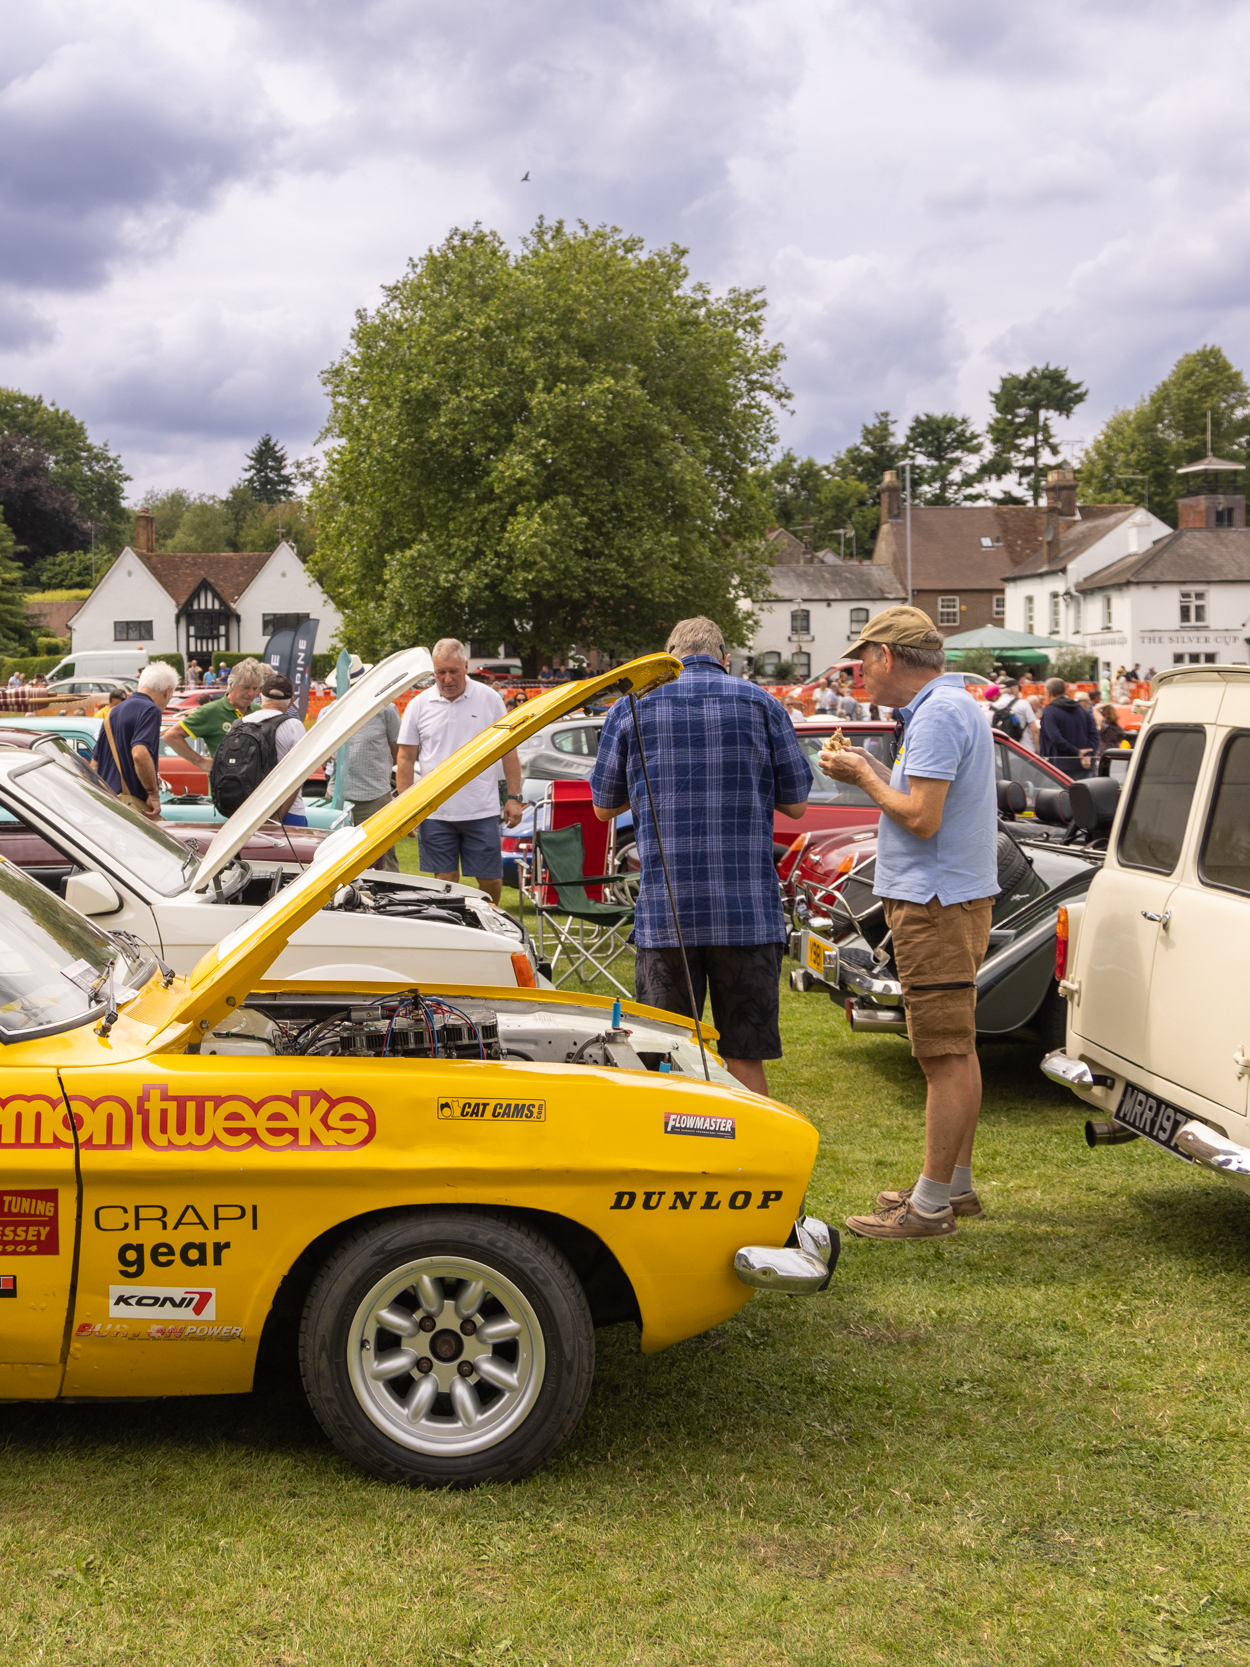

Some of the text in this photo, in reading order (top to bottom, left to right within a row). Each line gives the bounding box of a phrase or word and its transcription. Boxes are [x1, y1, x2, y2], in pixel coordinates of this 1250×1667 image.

[1140, 635, 1240, 645] THE SILVER CUP
[293, 639, 307, 709] ALPINE
[139, 1085, 375, 1150] tweeks
[460, 1102, 490, 1118] CAT
[1119, 1086, 1188, 1155] MRR 197
[666, 1114, 733, 1132] FLOWMASTER
[3, 1195, 55, 1217] TUNING
[610, 1190, 784, 1210] DUNLOP
[94, 1204, 258, 1232] CRAPI
[117, 1241, 231, 1279] gear
[113, 1293, 203, 1313] KONI
[75, 1323, 243, 1338] BUON POWER
